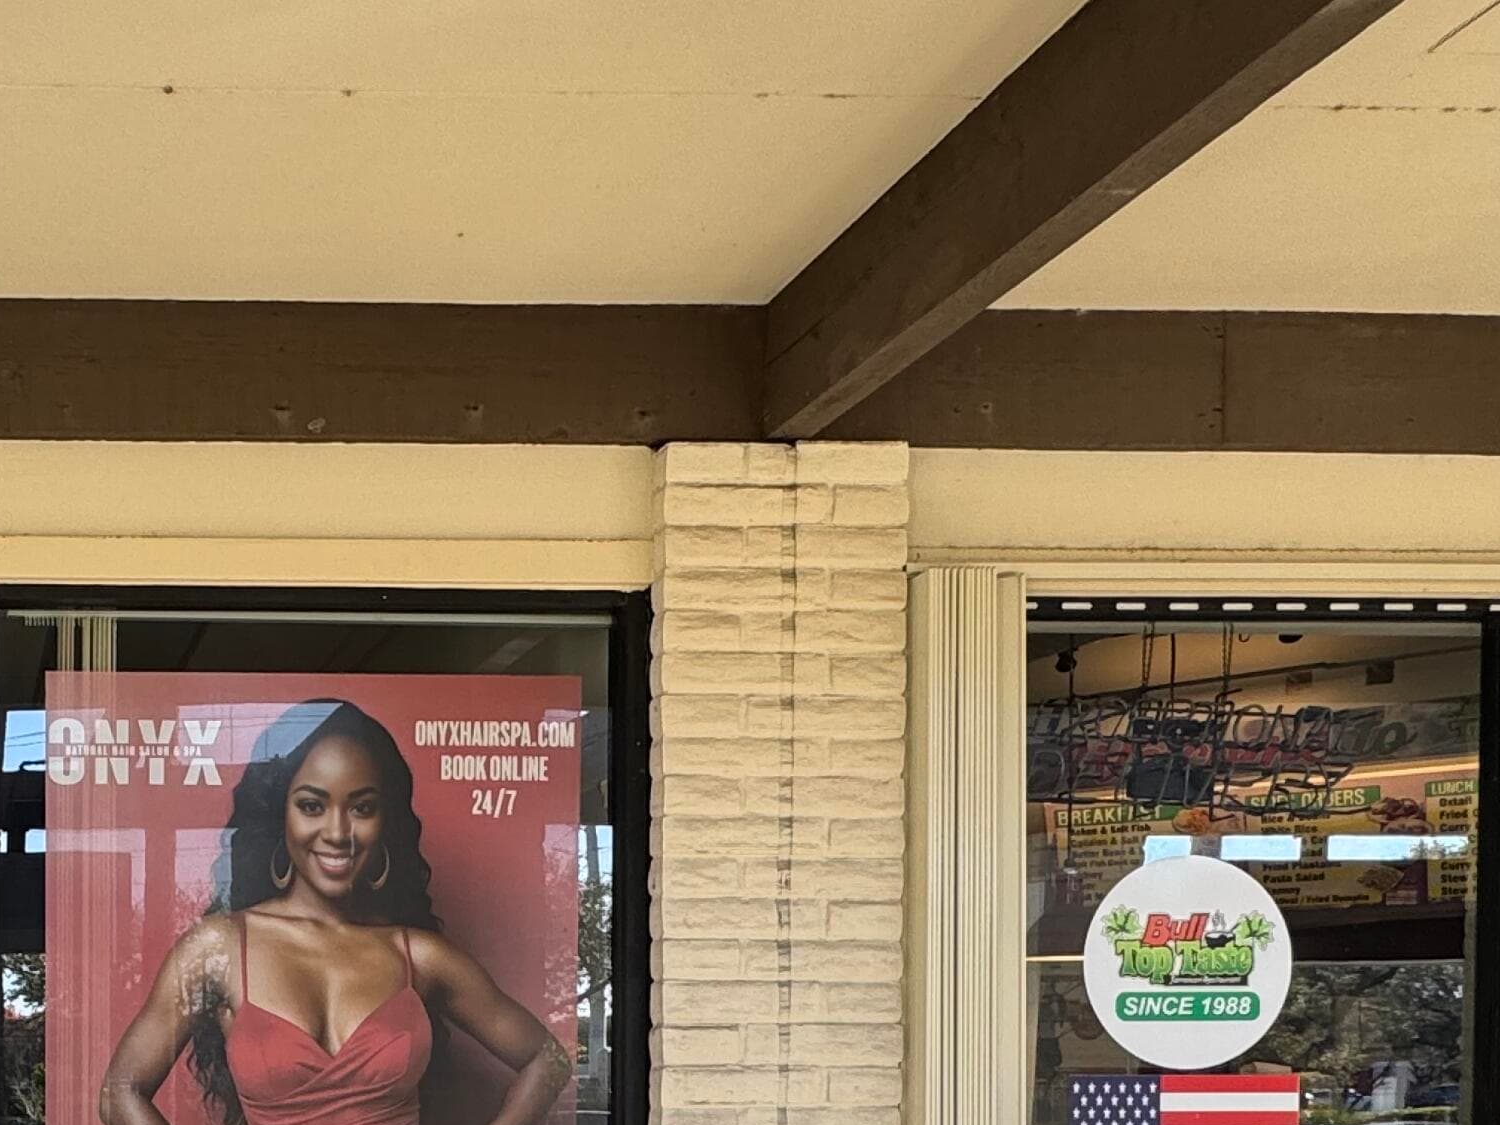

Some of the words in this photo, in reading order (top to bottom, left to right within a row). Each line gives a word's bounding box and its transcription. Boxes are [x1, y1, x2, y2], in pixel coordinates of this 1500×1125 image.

[415, 720, 576, 747] ONYXHAIRSPA.COM
[49, 718, 223, 786] ONYX
[65, 745, 108, 756] NATURAL
[112, 745, 135, 756] HAIR
[139, 745, 170, 756] SALON
[173, 745, 181, 756] &
[183, 745, 201, 756] SPA
[440, 755, 487, 781] BOOK
[490, 755, 549, 781] ONLINE
[1431, 781, 1474, 795] LUNCH
[472, 788, 518, 818] 24/7
[1142, 913, 1209, 946] Bull
[1114, 939, 1175, 985] Top
[1174, 940, 1256, 977] Taste
[1123, 996, 1194, 1016] SINCE
[1201, 996, 1252, 1016] 1988
